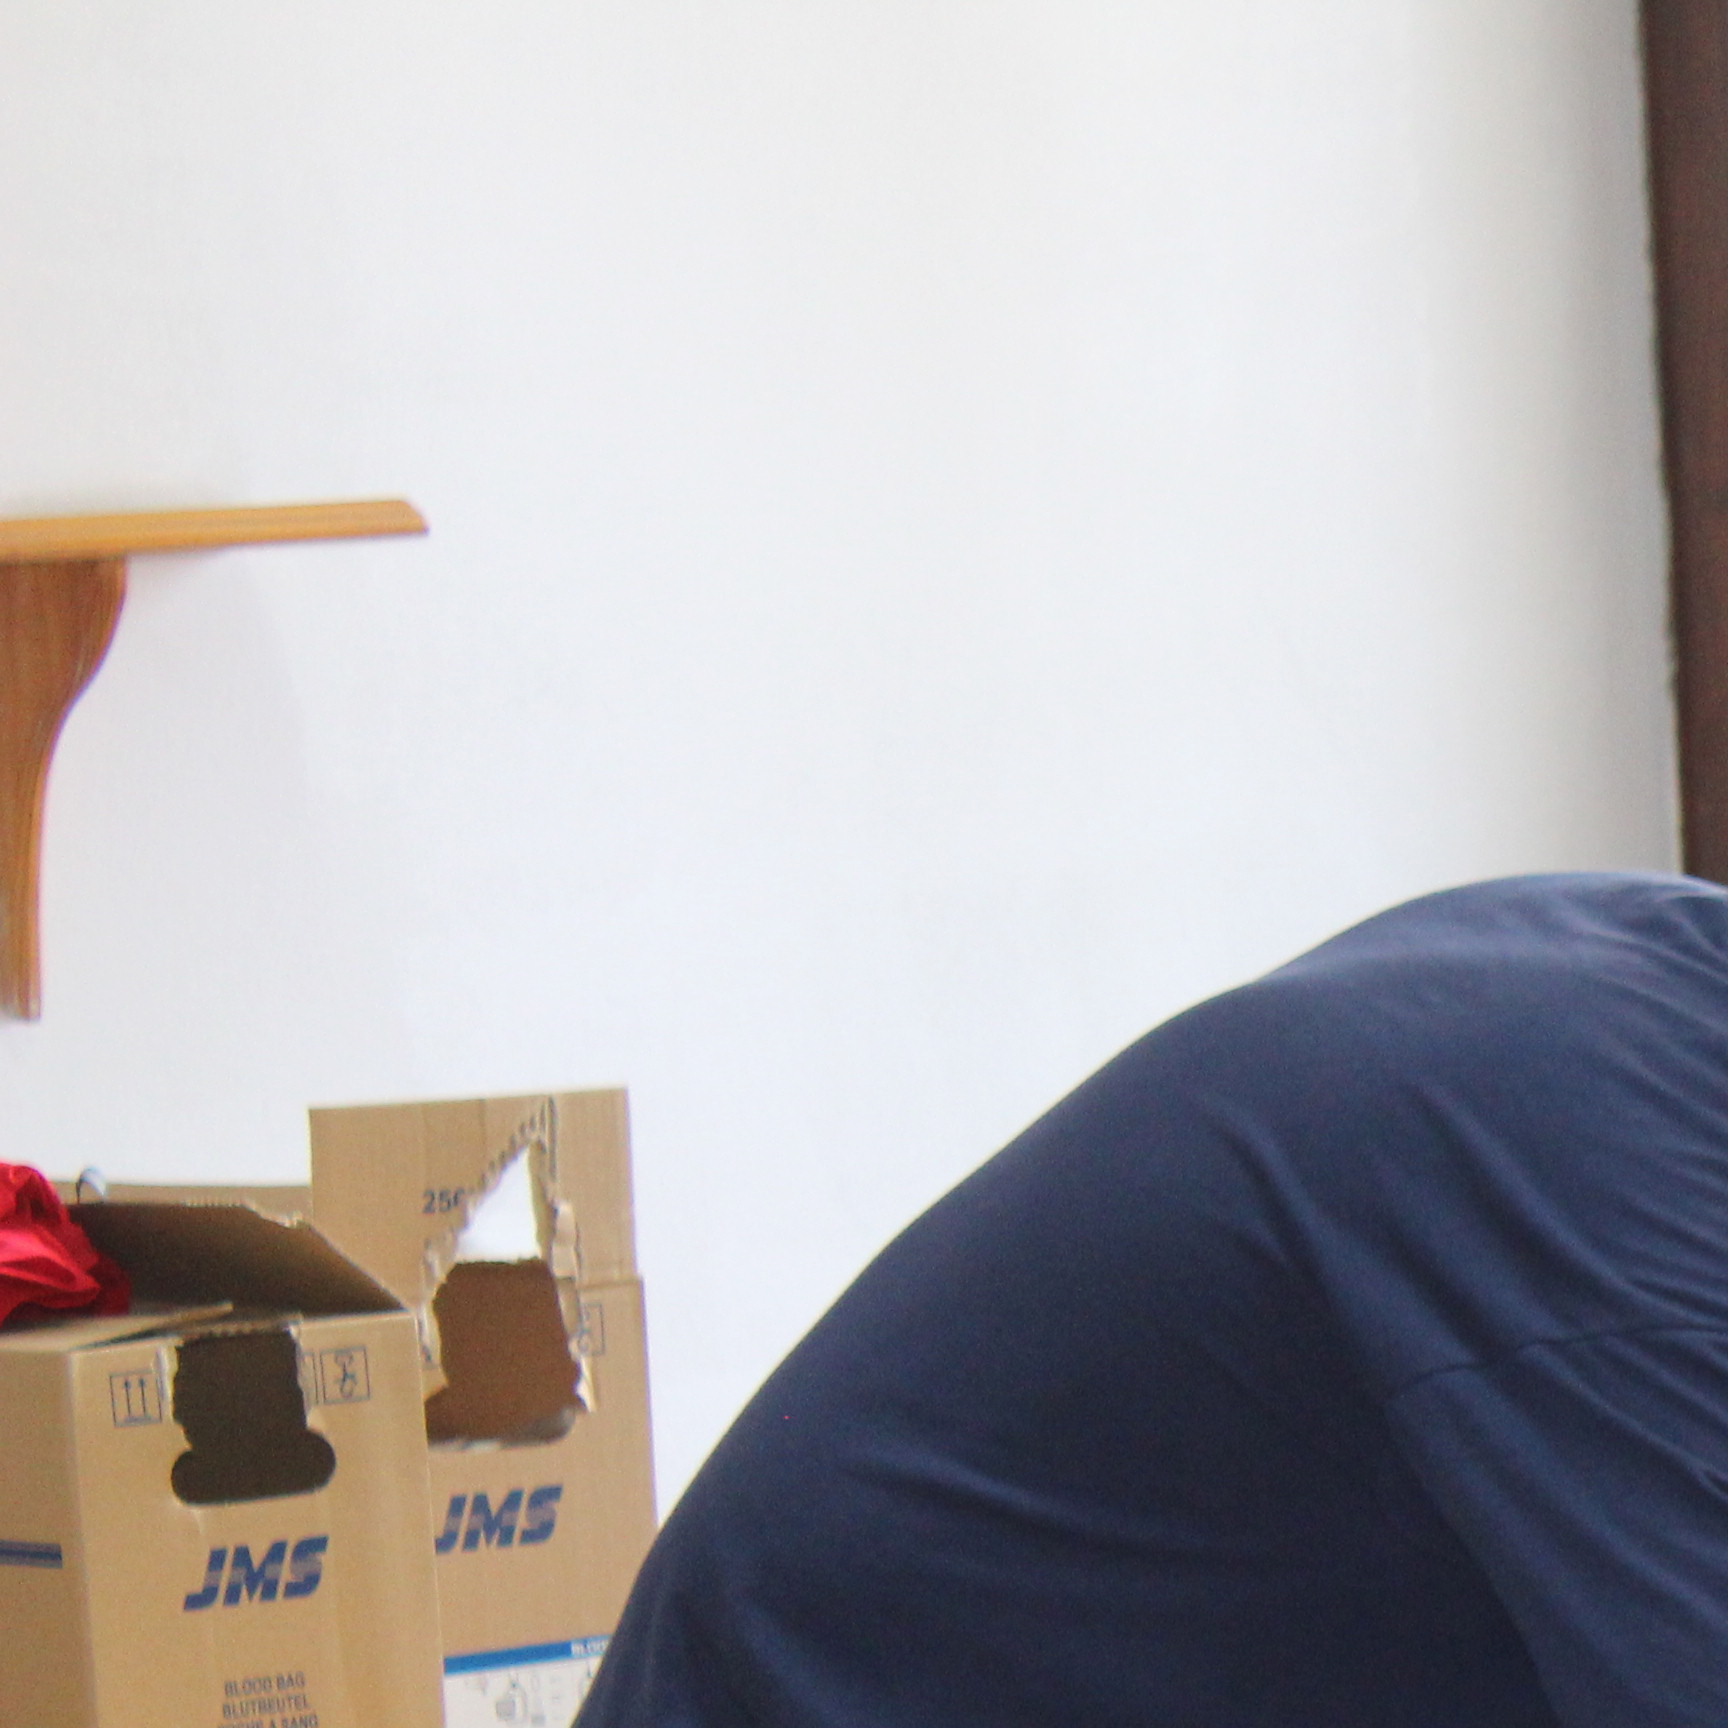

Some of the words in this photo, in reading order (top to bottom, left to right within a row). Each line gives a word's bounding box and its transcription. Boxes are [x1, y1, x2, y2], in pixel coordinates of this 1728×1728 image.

[434, 1484, 563, 1555] JMS
[183, 1535, 329, 1612] JMS
[224, 1677, 272, 1697] BLOOD
[276, 1671, 305, 1690] BAG
